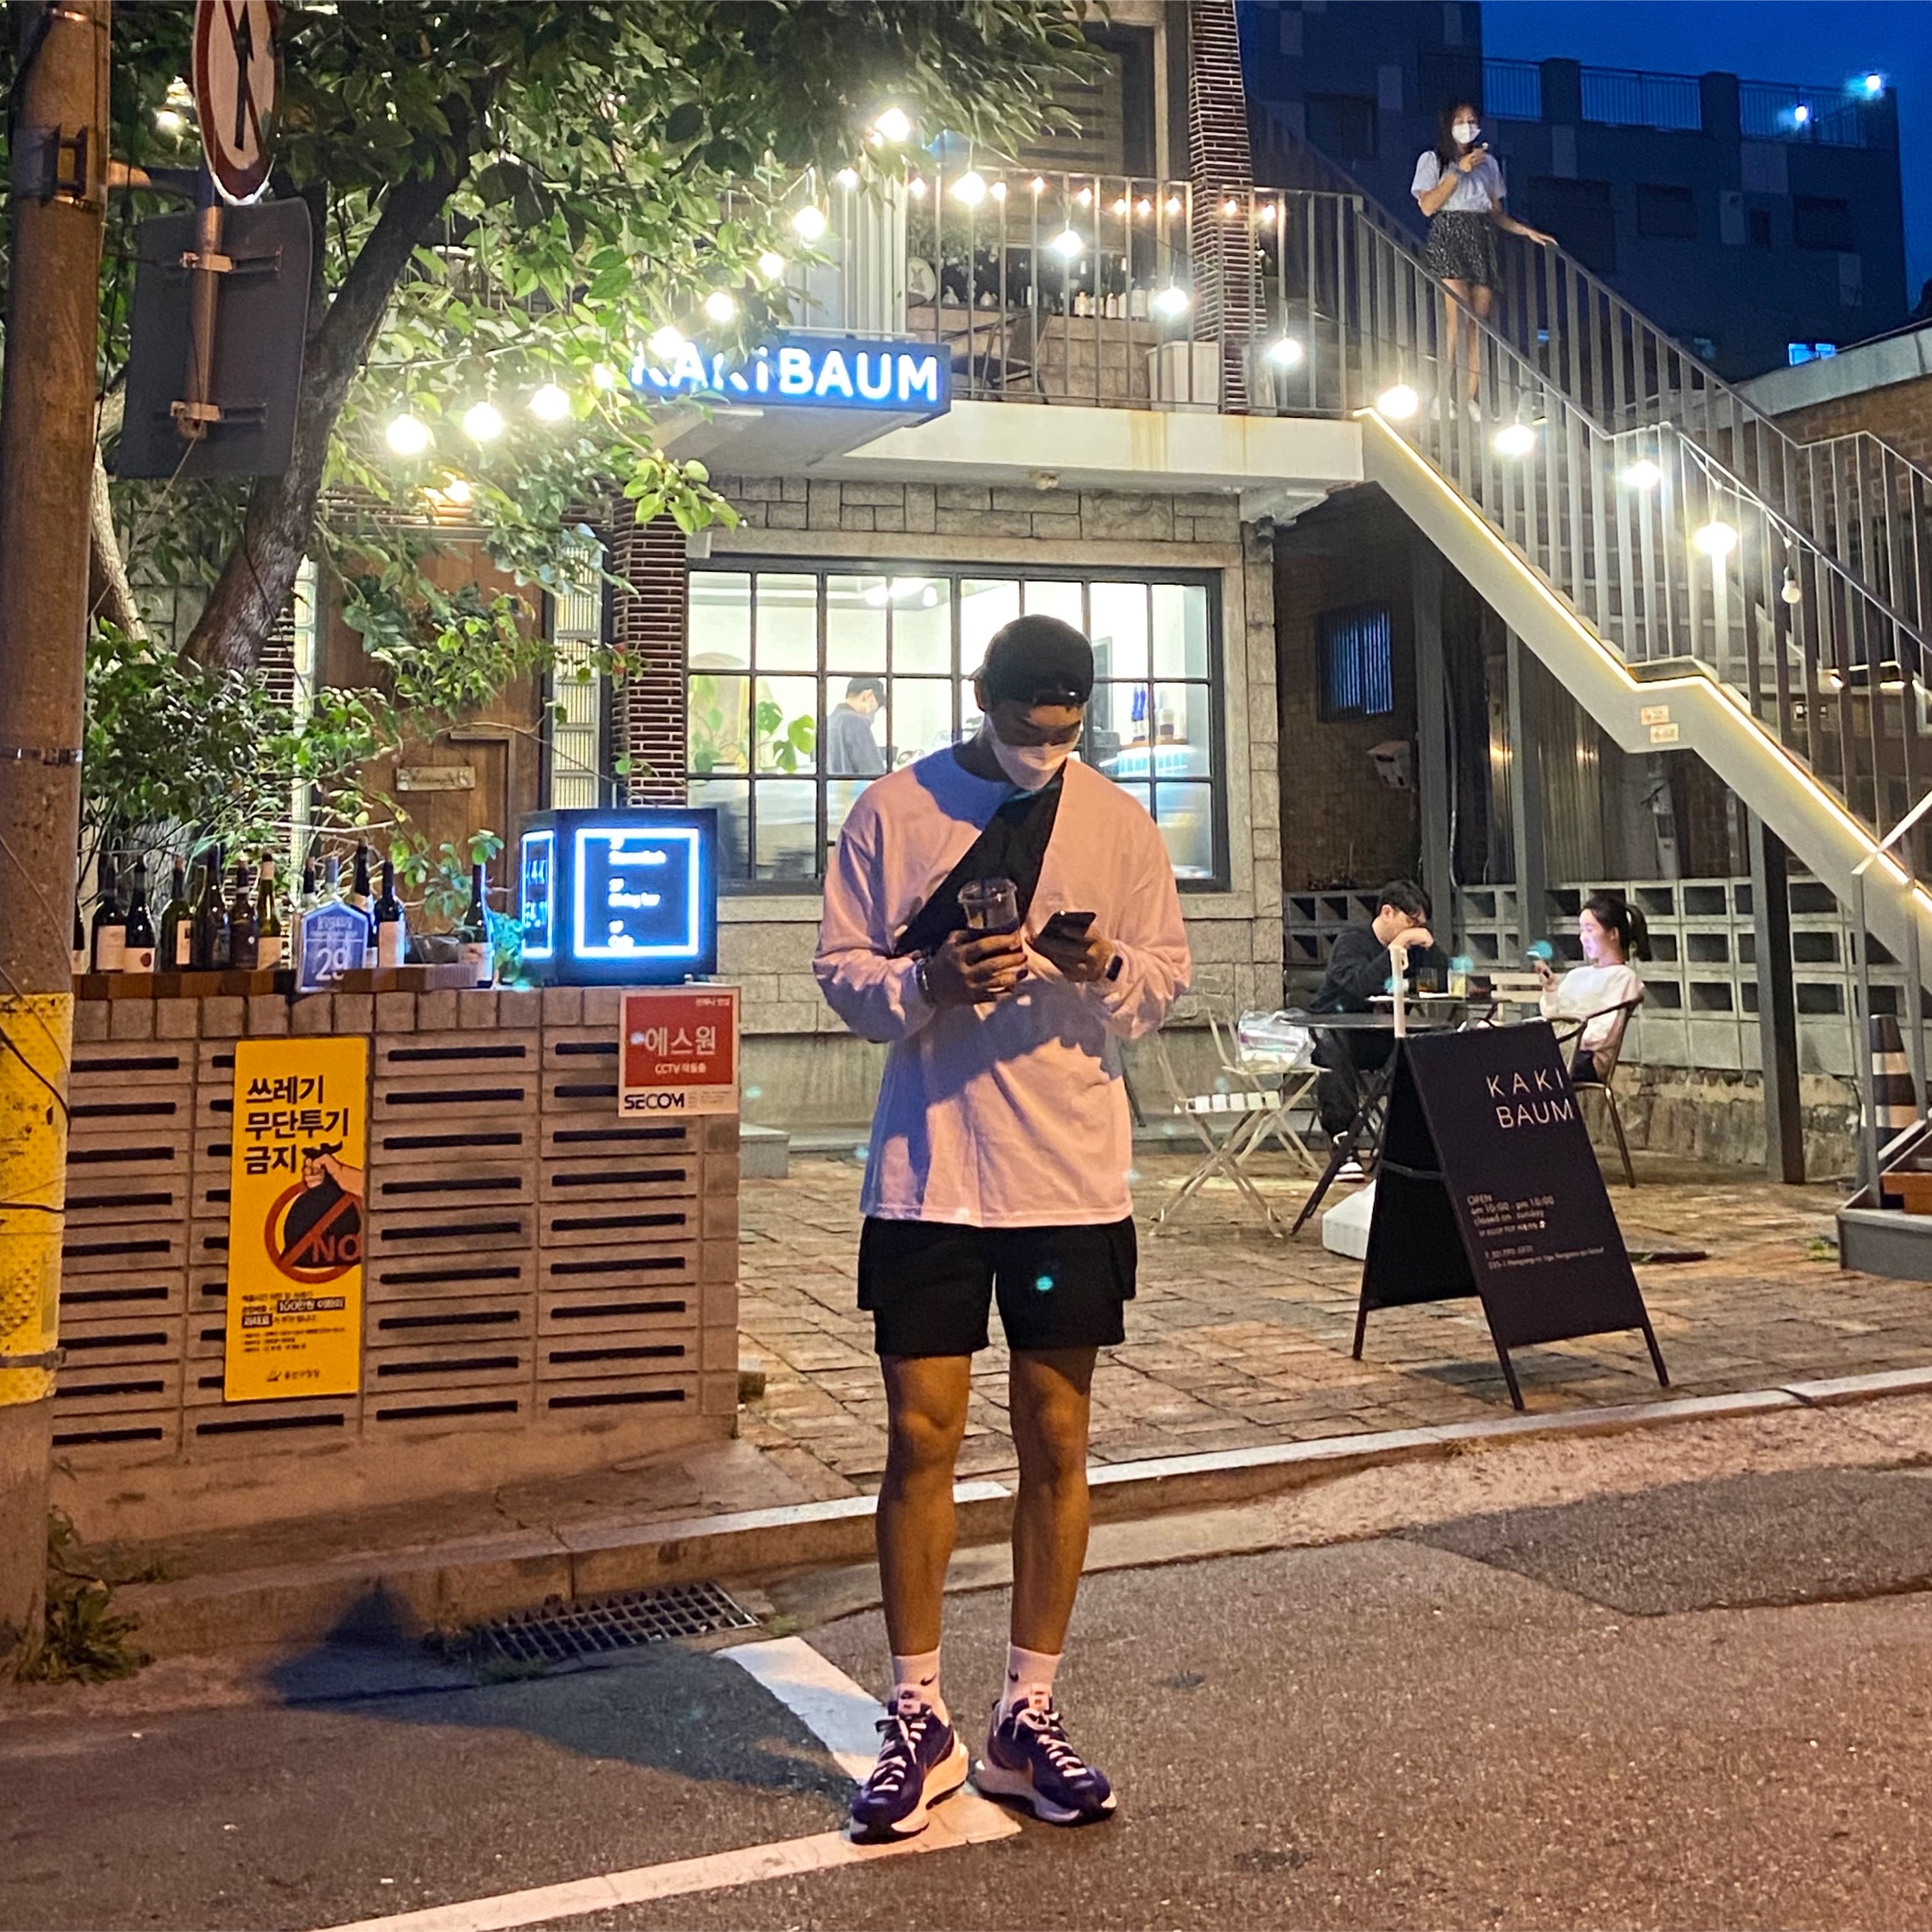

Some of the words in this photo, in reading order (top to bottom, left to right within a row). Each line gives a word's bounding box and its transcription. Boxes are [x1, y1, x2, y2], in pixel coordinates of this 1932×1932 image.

[315, 948, 352, 980] 29
[645, 1026, 716, 1056] 에스원
[655, 1063, 681, 1075] CCTV
[1486, 1067, 1565, 1097] KAKI
[246, 1075, 324, 1104] 쓰레기
[624, 1093, 684, 1110] SECOM
[245, 1108, 348, 1140] 무단투기
[1496, 1098, 1574, 1128] BAUM
[244, 1144, 296, 1175] 금지
